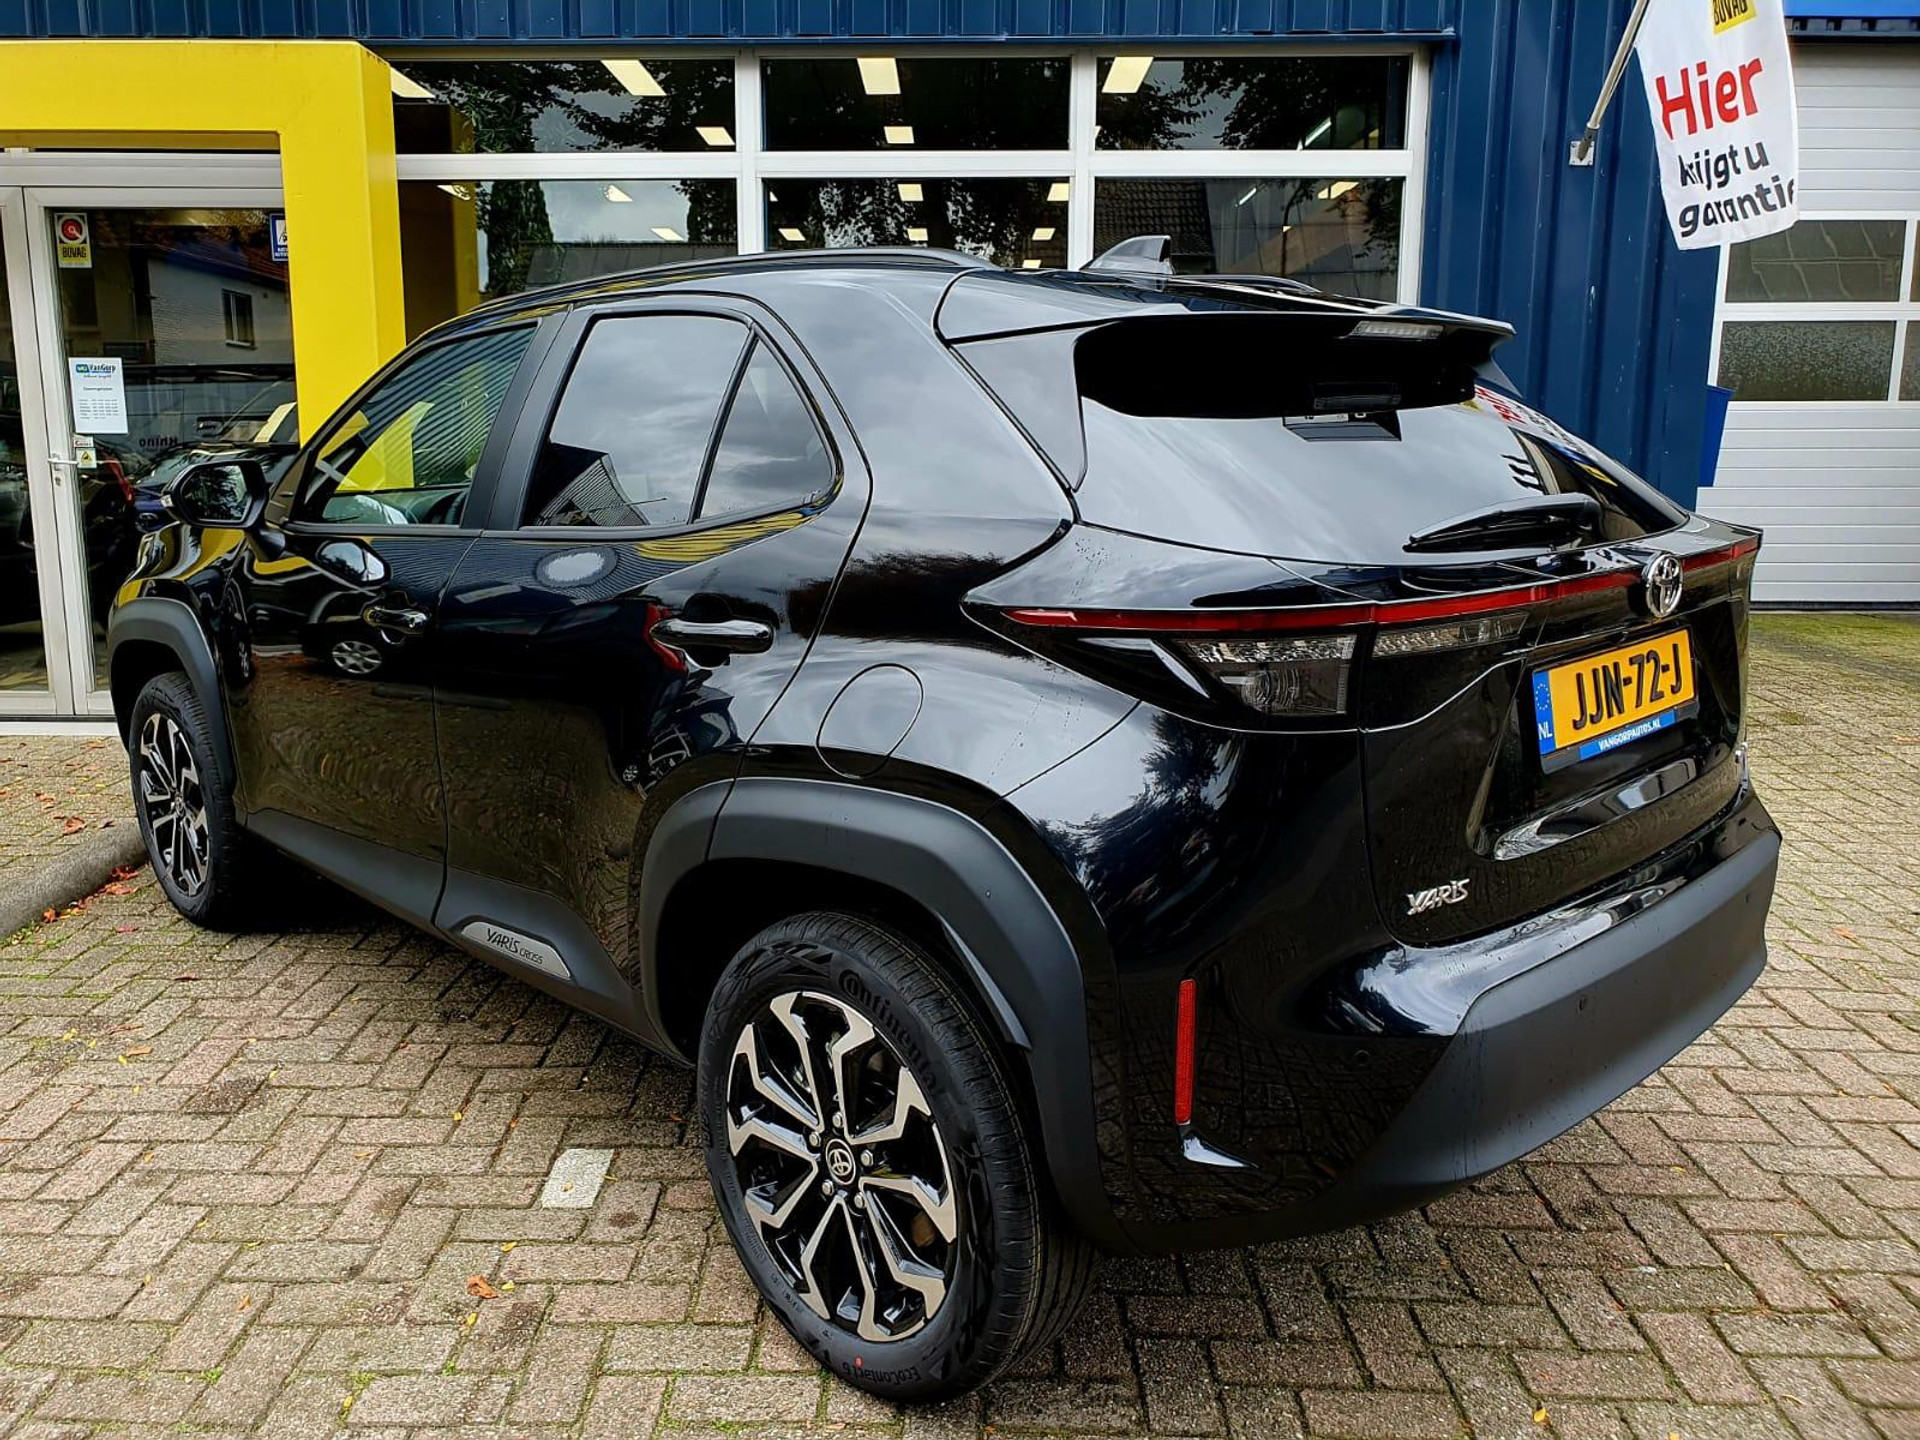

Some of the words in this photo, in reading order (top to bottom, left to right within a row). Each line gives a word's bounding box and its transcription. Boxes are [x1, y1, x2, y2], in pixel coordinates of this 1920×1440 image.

[1655, 57, 1764, 140] Hier
[1744, 141, 1770, 171] u
[62, 246, 88, 259] BOVAG
[1571, 643, 1683, 731] JJN-72-J
[1537, 721, 1553, 741] NL
[1597, 718, 1662, 751] VANGORPAUTOS.NL
